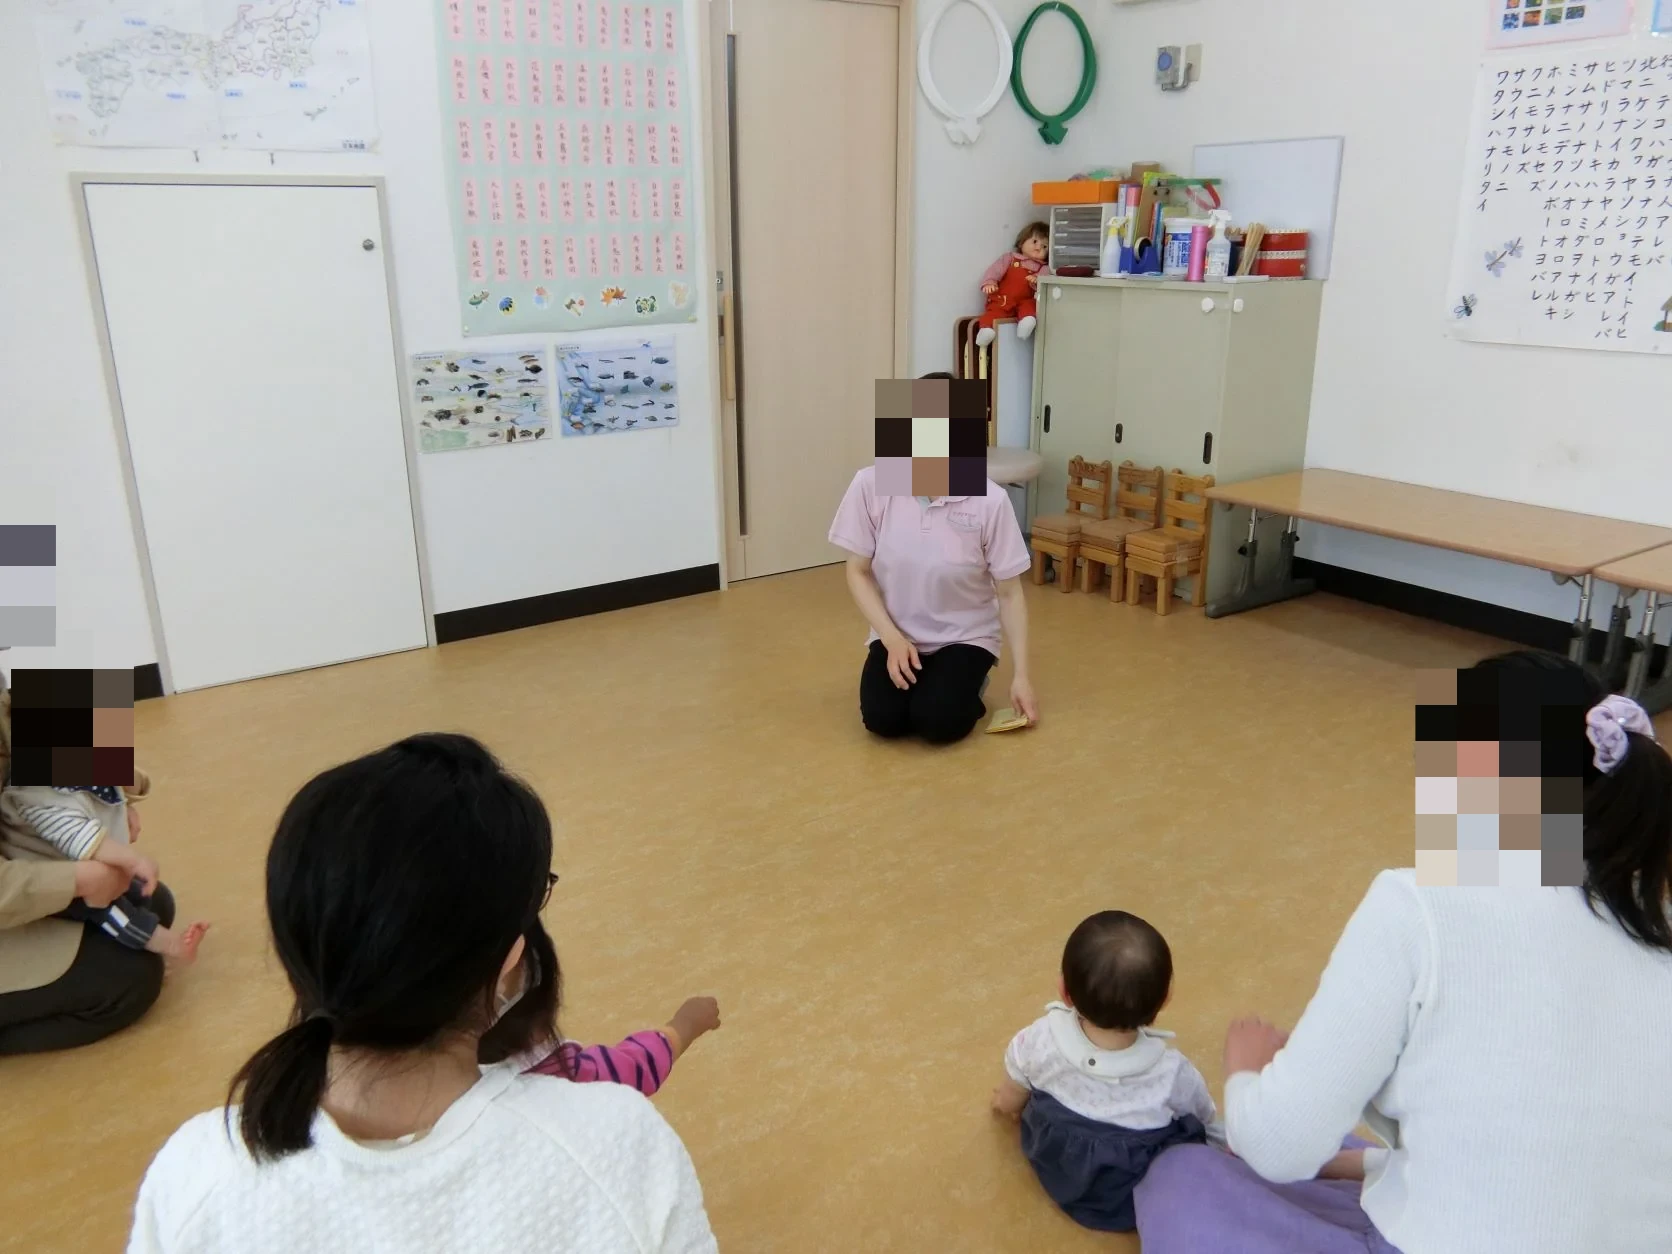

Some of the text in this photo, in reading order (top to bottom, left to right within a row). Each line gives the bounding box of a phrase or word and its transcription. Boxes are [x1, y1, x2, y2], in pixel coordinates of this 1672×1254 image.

[1476, 70, 1509, 211] ワタシハナリタイ
[1496, 68, 1526, 191] サウイフモノニ
[1517, 67, 1542, 173] クニモサレズ
[1530, 66, 1561, 191] ホメラレモセズ
[1531, 63, 1577, 300] ミンナニデクノボートヨバレ
[1545, 62, 1598, 319] サムサノナツハオロオロアルキ
[1563, 61, 1616, 319] ヒドリノトキハナミダヲナガシ
[1585, 58, 1636, 302] ツマラナイカラヤメロトイヒ
